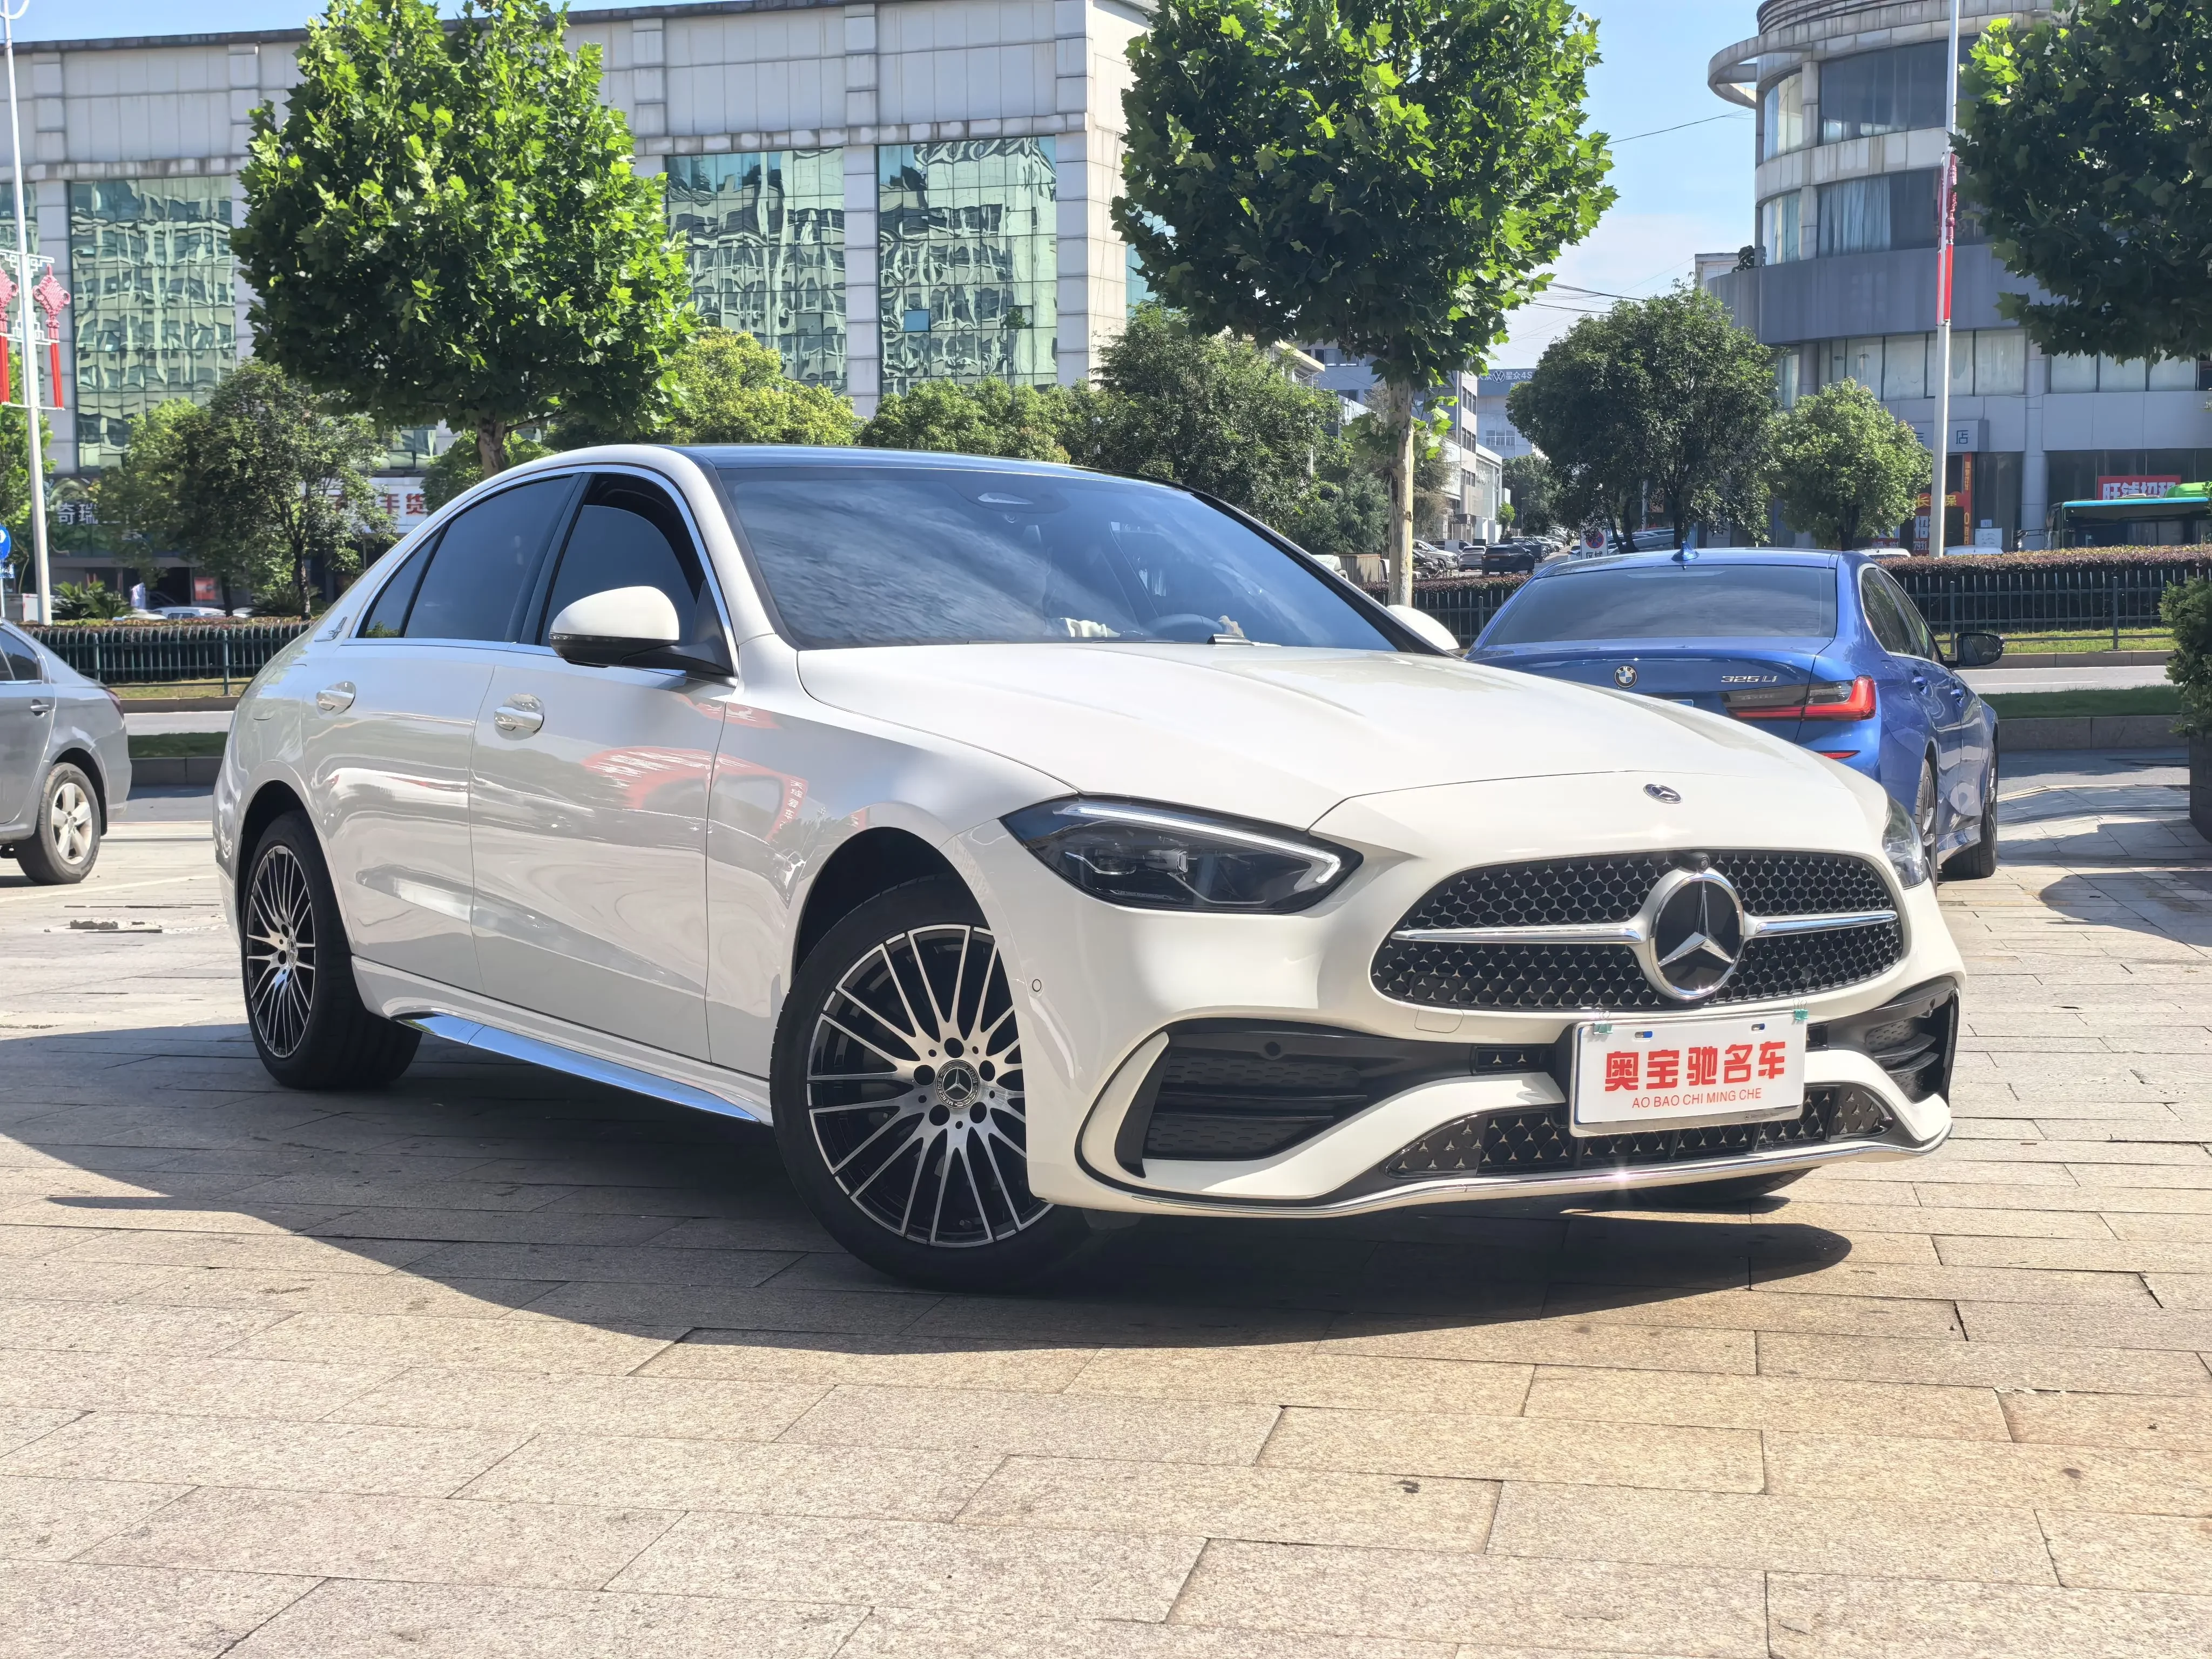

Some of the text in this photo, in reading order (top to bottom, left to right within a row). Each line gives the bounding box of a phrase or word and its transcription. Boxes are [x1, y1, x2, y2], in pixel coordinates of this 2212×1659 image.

[1605, 1041, 1785, 1091] 奥宝驰名车
[1632, 1088, 1762, 1108] AO BAO CHI MING CHE
